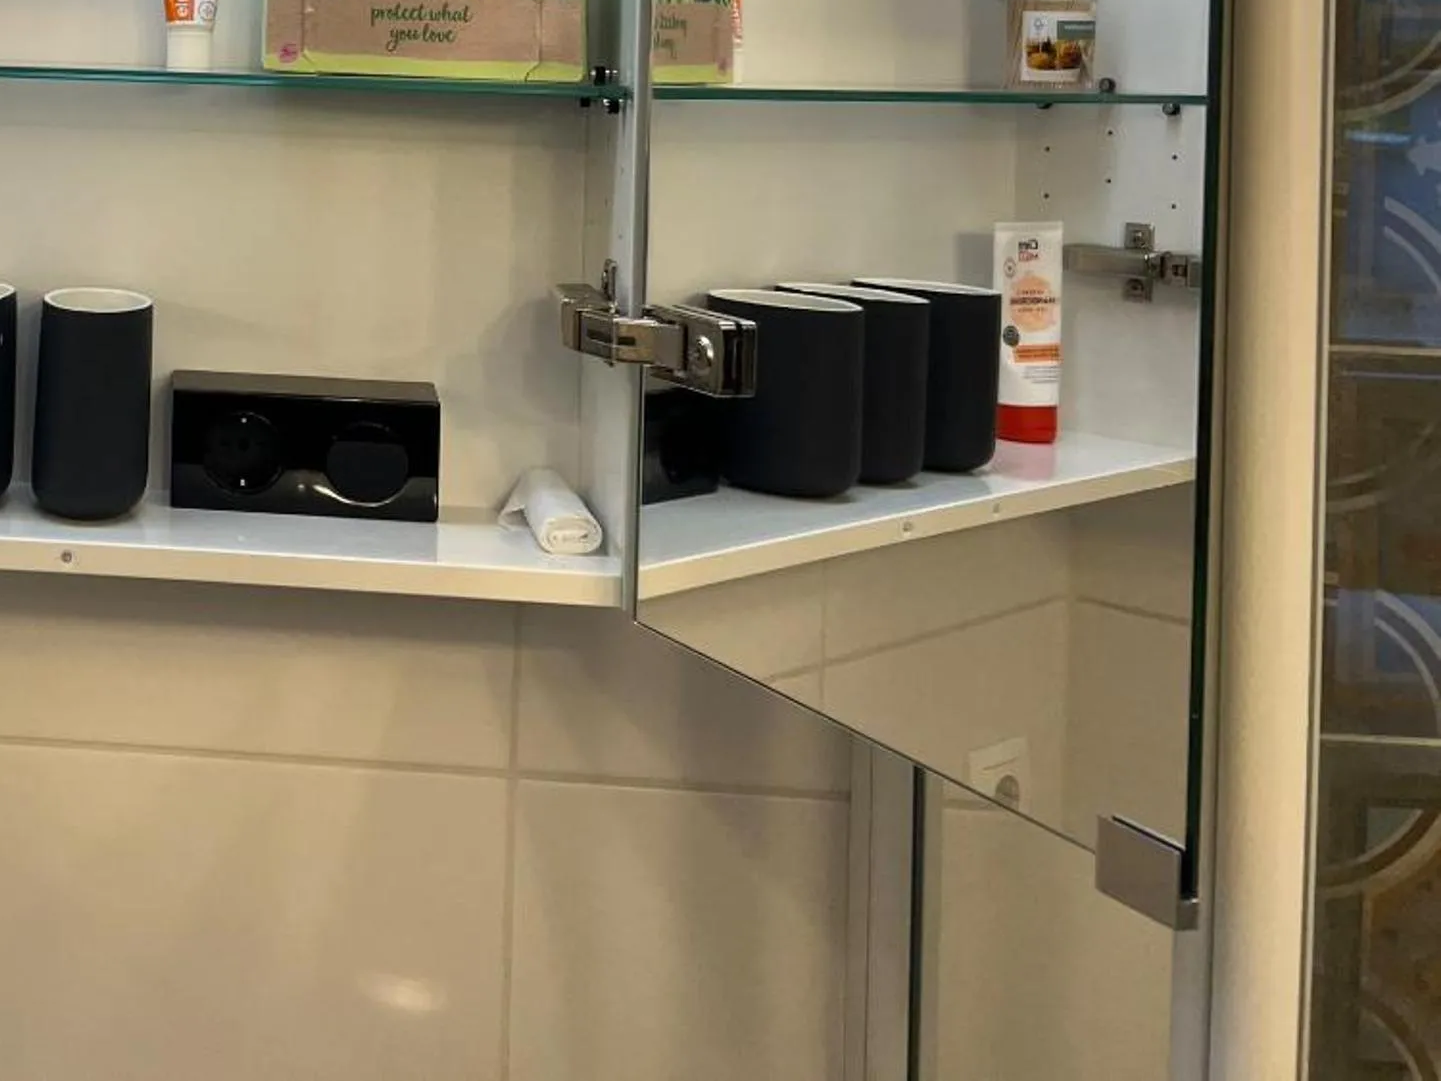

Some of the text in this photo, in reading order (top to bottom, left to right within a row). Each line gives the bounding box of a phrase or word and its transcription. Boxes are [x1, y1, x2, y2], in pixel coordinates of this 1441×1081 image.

[370, 1, 472, 27] protect what
[386, 23, 456, 52] you love
